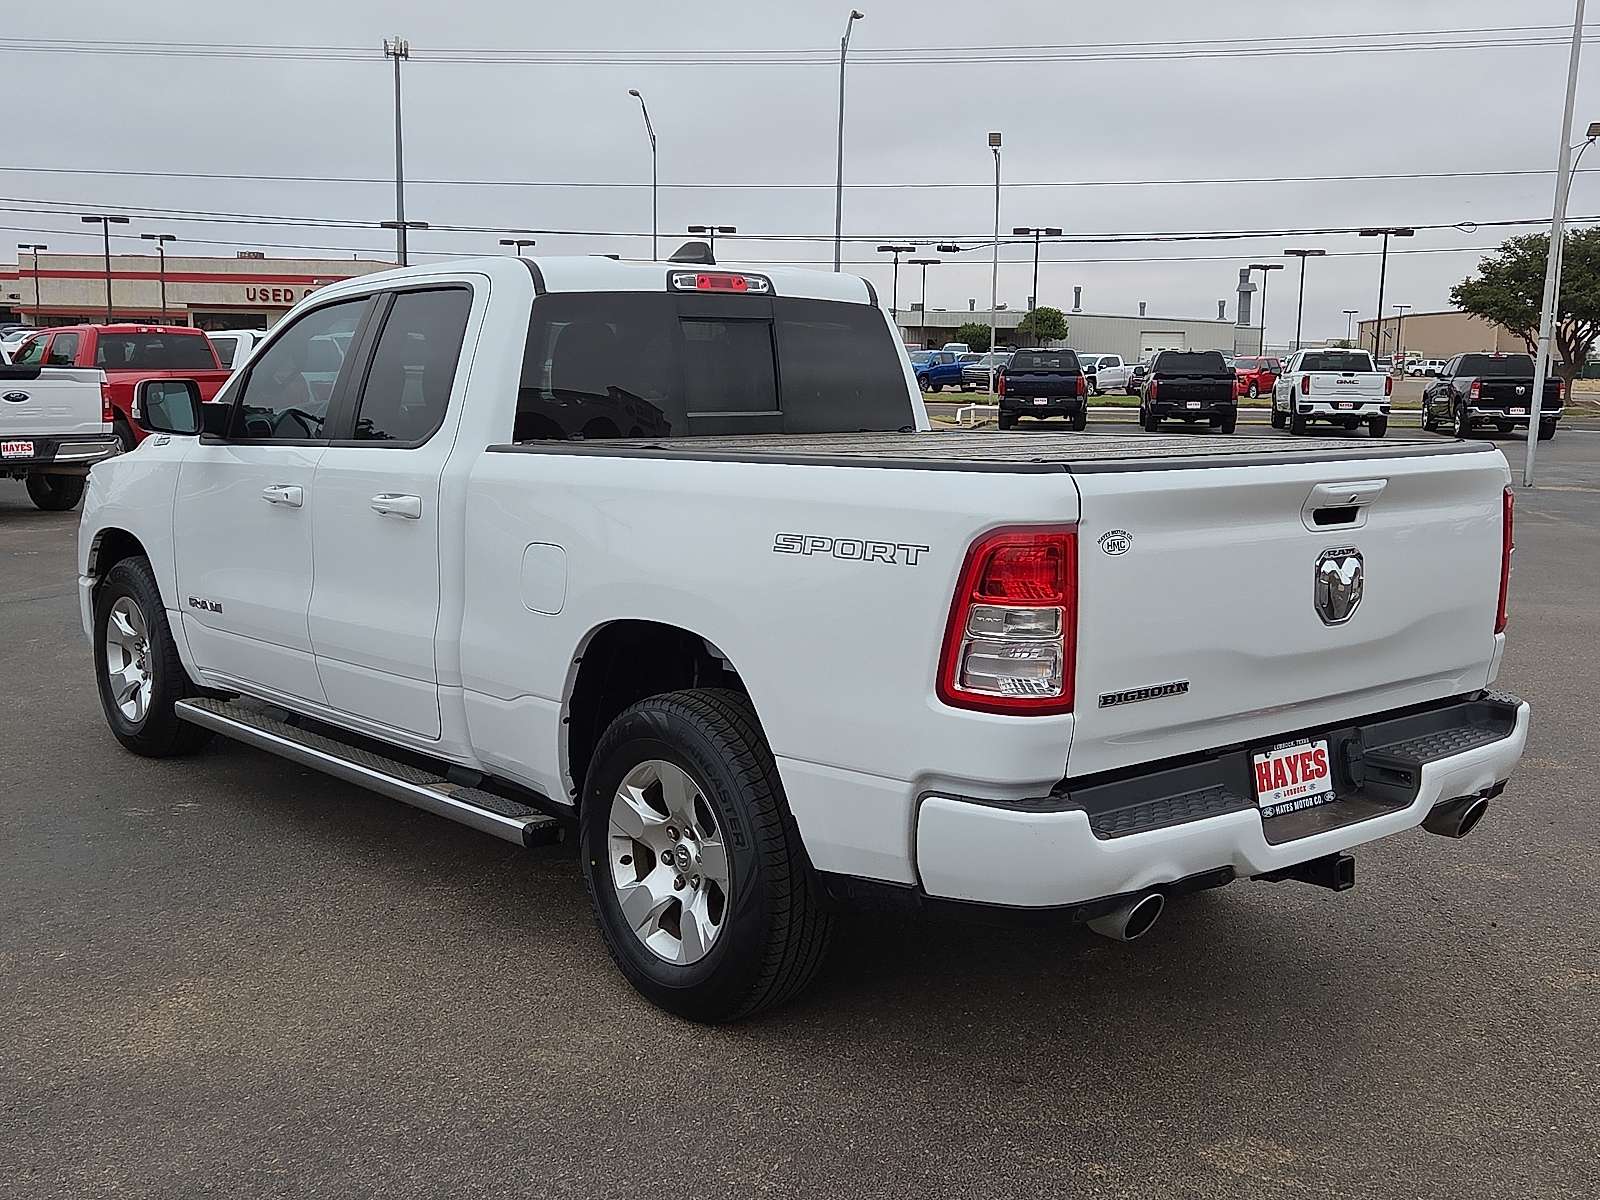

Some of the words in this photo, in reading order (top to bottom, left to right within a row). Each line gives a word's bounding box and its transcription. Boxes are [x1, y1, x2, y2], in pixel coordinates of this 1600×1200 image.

[245, 287, 294, 303] USED
[2, 443, 33, 453] HAYES
[772, 533, 930, 567] SPORT
[1107, 538, 1125, 552] HMC
[188, 596, 223, 614] RAM
[1099, 680, 1190, 709] BIGHORN
[1256, 749, 1327, 792] HAYES
[1275, 801, 1294, 815] HAYES
[1294, 797, 1314, 811] MOTOR
[1313, 794, 1324, 805] CO.
